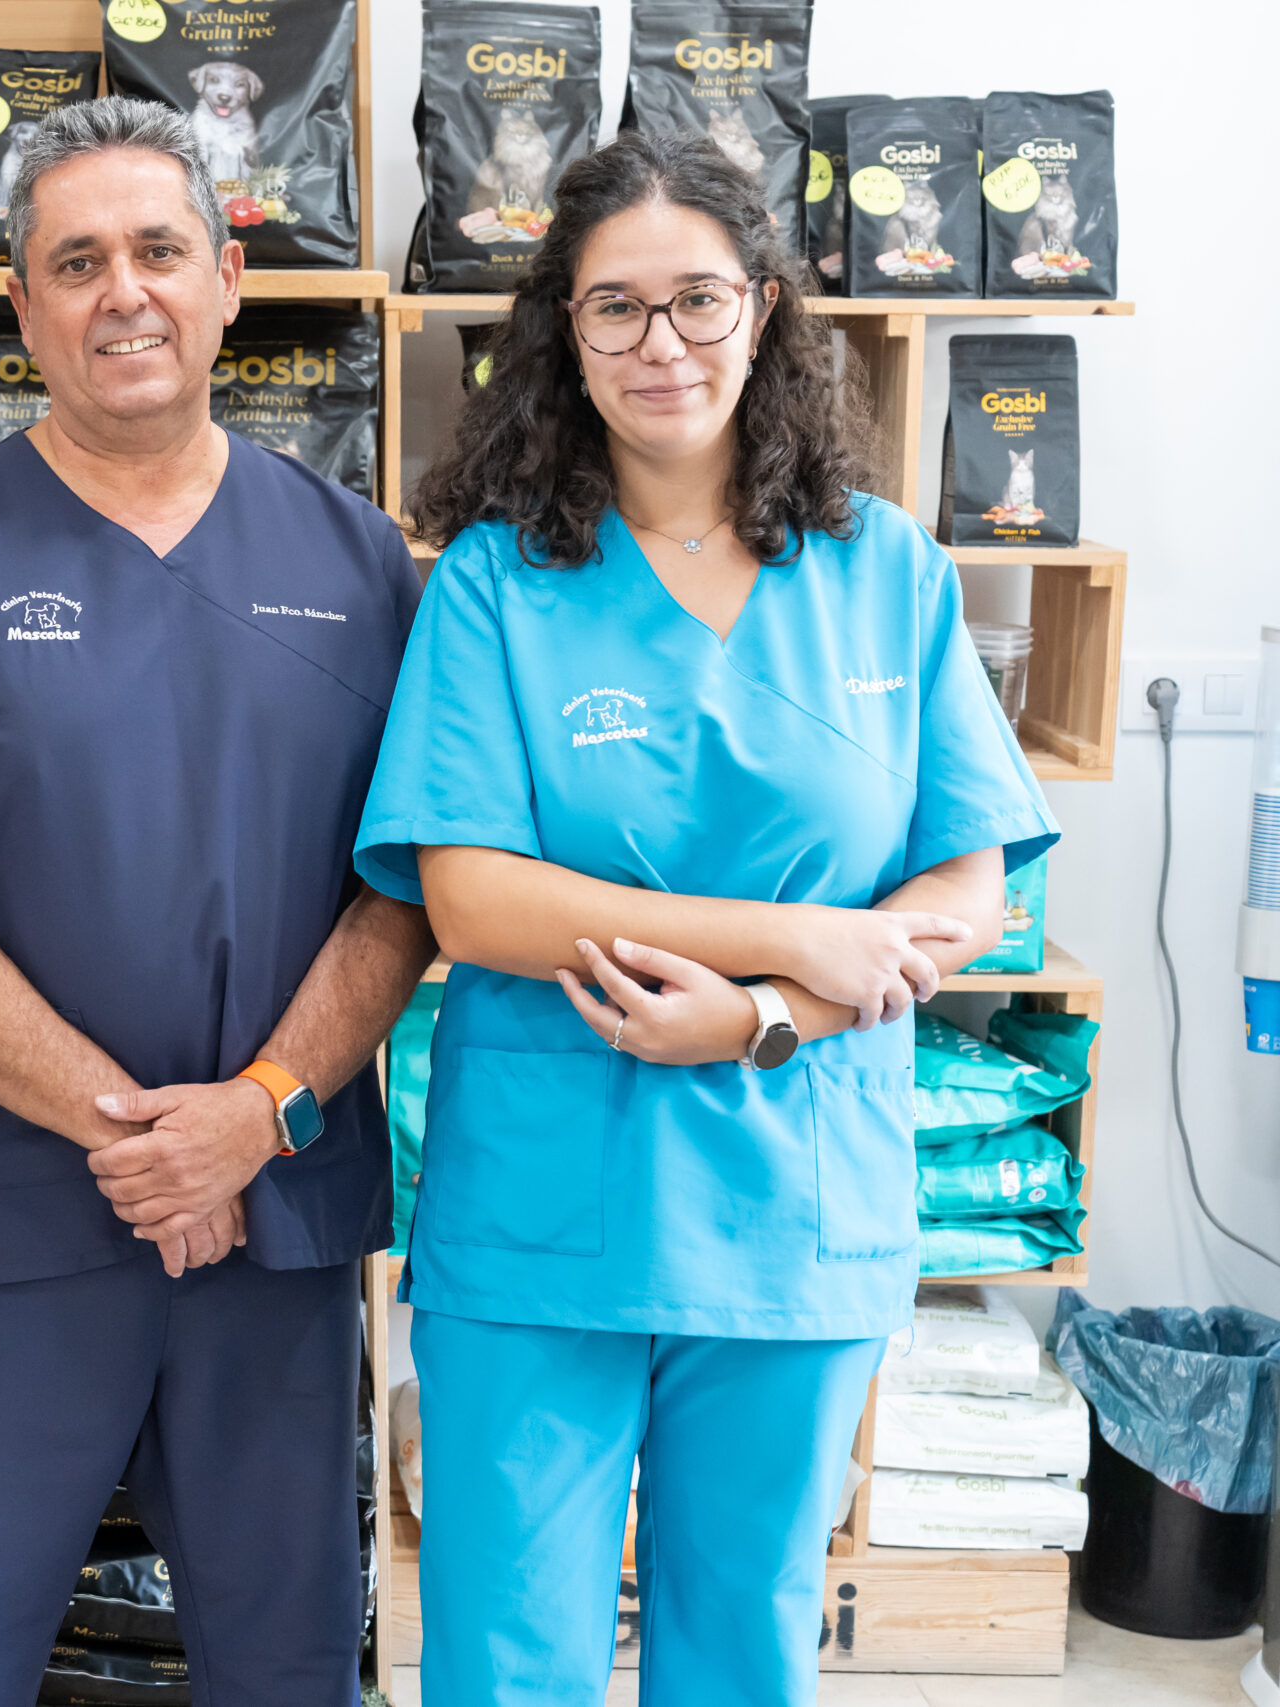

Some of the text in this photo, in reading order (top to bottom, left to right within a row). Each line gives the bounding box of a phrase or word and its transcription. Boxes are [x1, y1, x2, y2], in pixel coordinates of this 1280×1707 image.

[185, 9, 271, 25] Exclusive
[180, 25, 277, 41] Grain Free
[466, 43, 567, 80] Gosbi
[675, 38, 773, 71] Gosbi
[1, 71, 84, 94] Gosbi
[486, 78, 547, 91] Exclusive
[694, 73, 753, 87] Exclusive
[483, 89, 521, 99] Grain
[690, 86, 758, 97] Grain Free
[880, 144, 941, 165] Gosbi
[1017, 142, 1078, 160] Gosbi
[491, 253, 514, 263] Duck
[209, 347, 336, 387] Gosbi
[227, 391, 309, 407] Exclusive
[981, 392, 1046, 413] Gosbi
[223, 407, 313, 424] Grain Free
[994, 414, 1034, 424] Exclusive
[1028, 528, 1041, 536] Fish
[251, 603, 280, 614] Juan
[280, 605, 303, 616] Fco.
[7, 627, 81, 641] Mascotas
[572, 726, 649, 748] Mascotas
[937, 1343, 974, 1355] Gosbi
[958, 1404, 1008, 1421] Gosbi
[955, 1475, 1007, 1493] Gosbi
[150, 1660, 173, 1670] Grain
